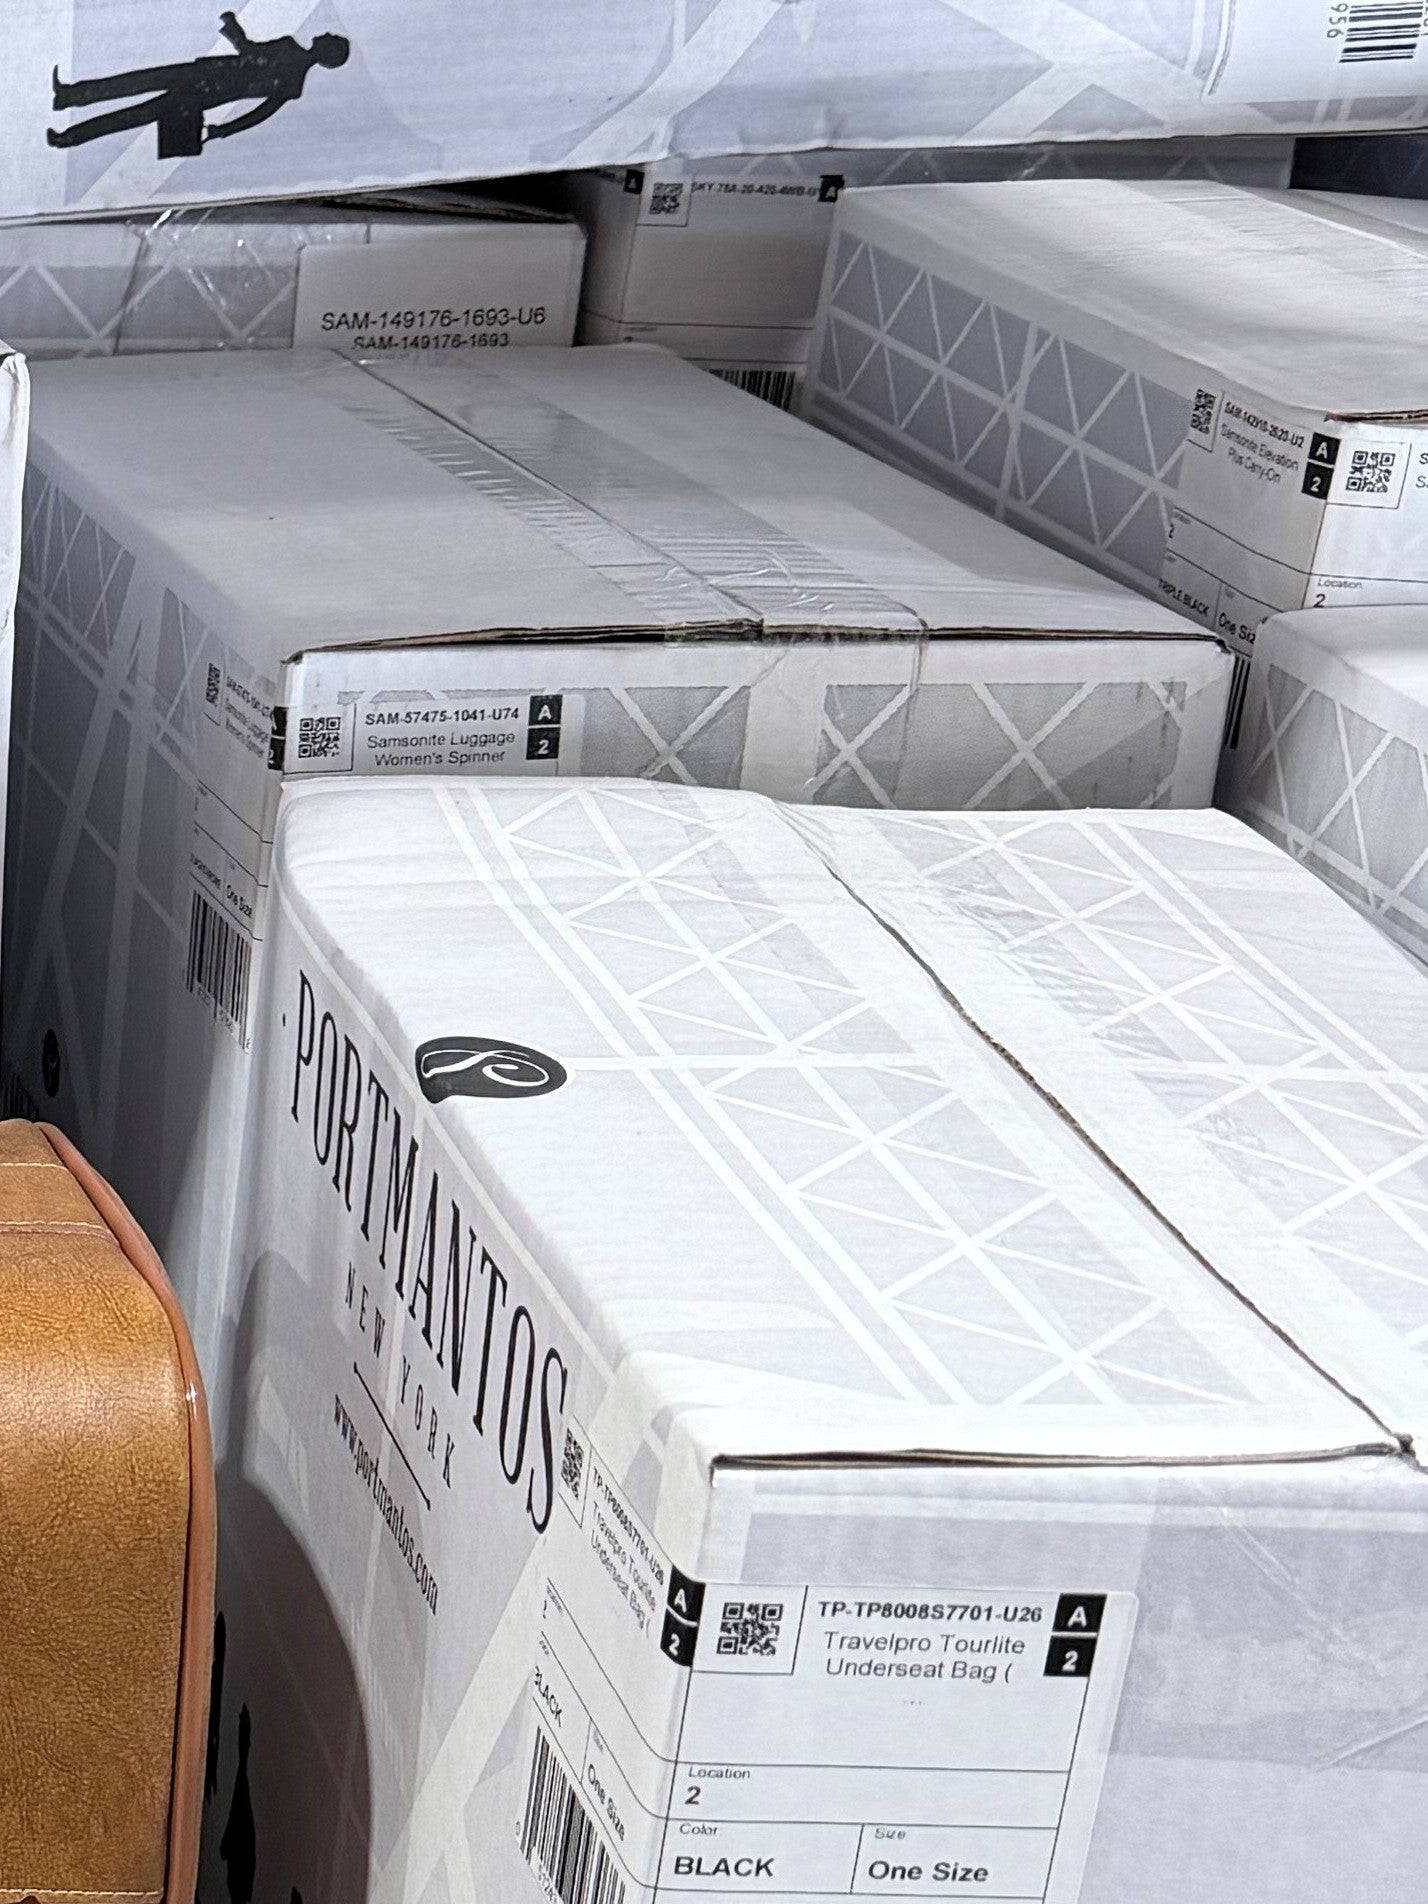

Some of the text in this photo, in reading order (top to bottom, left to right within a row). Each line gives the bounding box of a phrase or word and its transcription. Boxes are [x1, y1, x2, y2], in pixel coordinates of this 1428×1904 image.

[320, 306, 546, 332] SAM-149176-1693-U6
[352, 331, 511, 351] SAM-149176-1693
[1315, 442, 1329, 459] A
[1310, 476, 1320, 492] 2
[1318, 577, 1363, 589] Location
[1313, 593, 1326, 608] 2
[1218, 612, 1237, 636] One
[364, 705, 553, 726] SAM-57475-1041-U74 A
[367, 732, 550, 755] Samsonite Luggage 2
[374, 750, 506, 767] Women's Spinner
[290, 969, 568, 1535] PORTMANTOS
[345, 1260, 457, 1489] NEW YORK
[333, 1393, 441, 1616] www.portmantos.com
[593, 1500, 627, 1566] Travelpro
[591, 1528, 630, 1600] Underseat
[629, 1589, 645, 1630] Bag
[669, 1632, 681, 1656] 2
[674, 1587, 687, 1613] A
[817, 1599, 1089, 1627] TP-TP8008S7701-U26 A
[823, 1629, 1027, 1655] Travelpro Tourlite
[825, 1649, 1080, 1685] Underseat Bag ( 2
[688, 1765, 752, 1780] Location
[587, 1762, 626, 1843] One Size
[684, 1786, 701, 1806] 2
[673, 1855, 989, 1884] BLACK One Size
